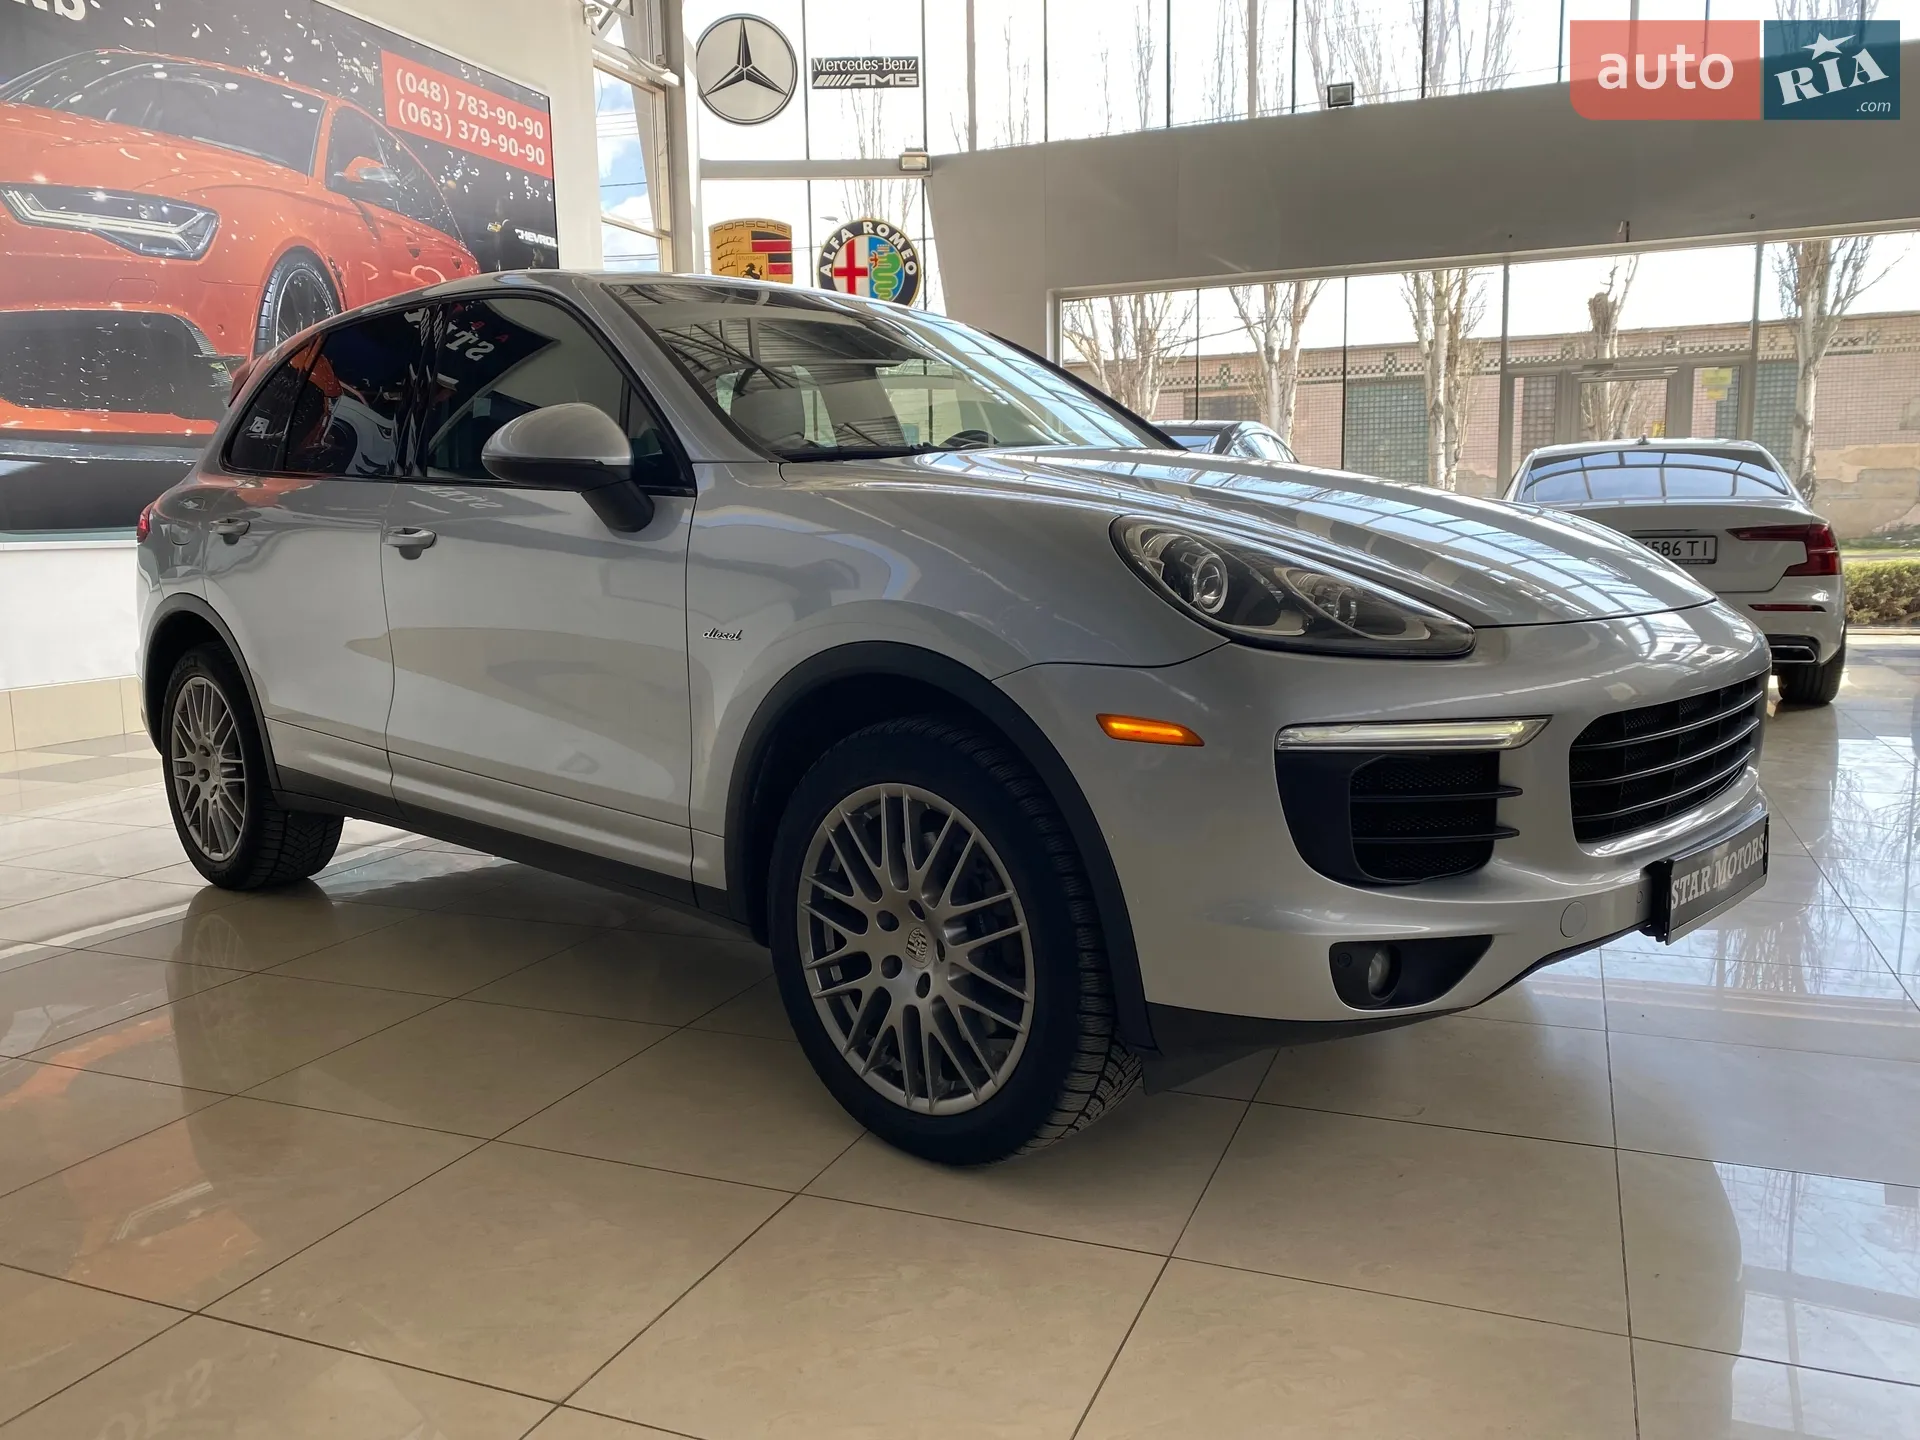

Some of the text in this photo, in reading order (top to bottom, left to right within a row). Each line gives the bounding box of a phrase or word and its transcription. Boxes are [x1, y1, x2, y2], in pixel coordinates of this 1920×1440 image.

[812, 57, 916, 72] Mercedes-Benz
[396, 68, 544, 140] (048) 783-90-90
[399, 98, 545, 166] (063) 379-90-90
[713, 220, 788, 234] PORSCHE
[820, 221, 917, 278] ALFA ROMEO
[1644, 540, 1707, 557] 586 TI
[702, 628, 743, 641] diesel
[1671, 833, 1765, 911] STAR MOTORS
